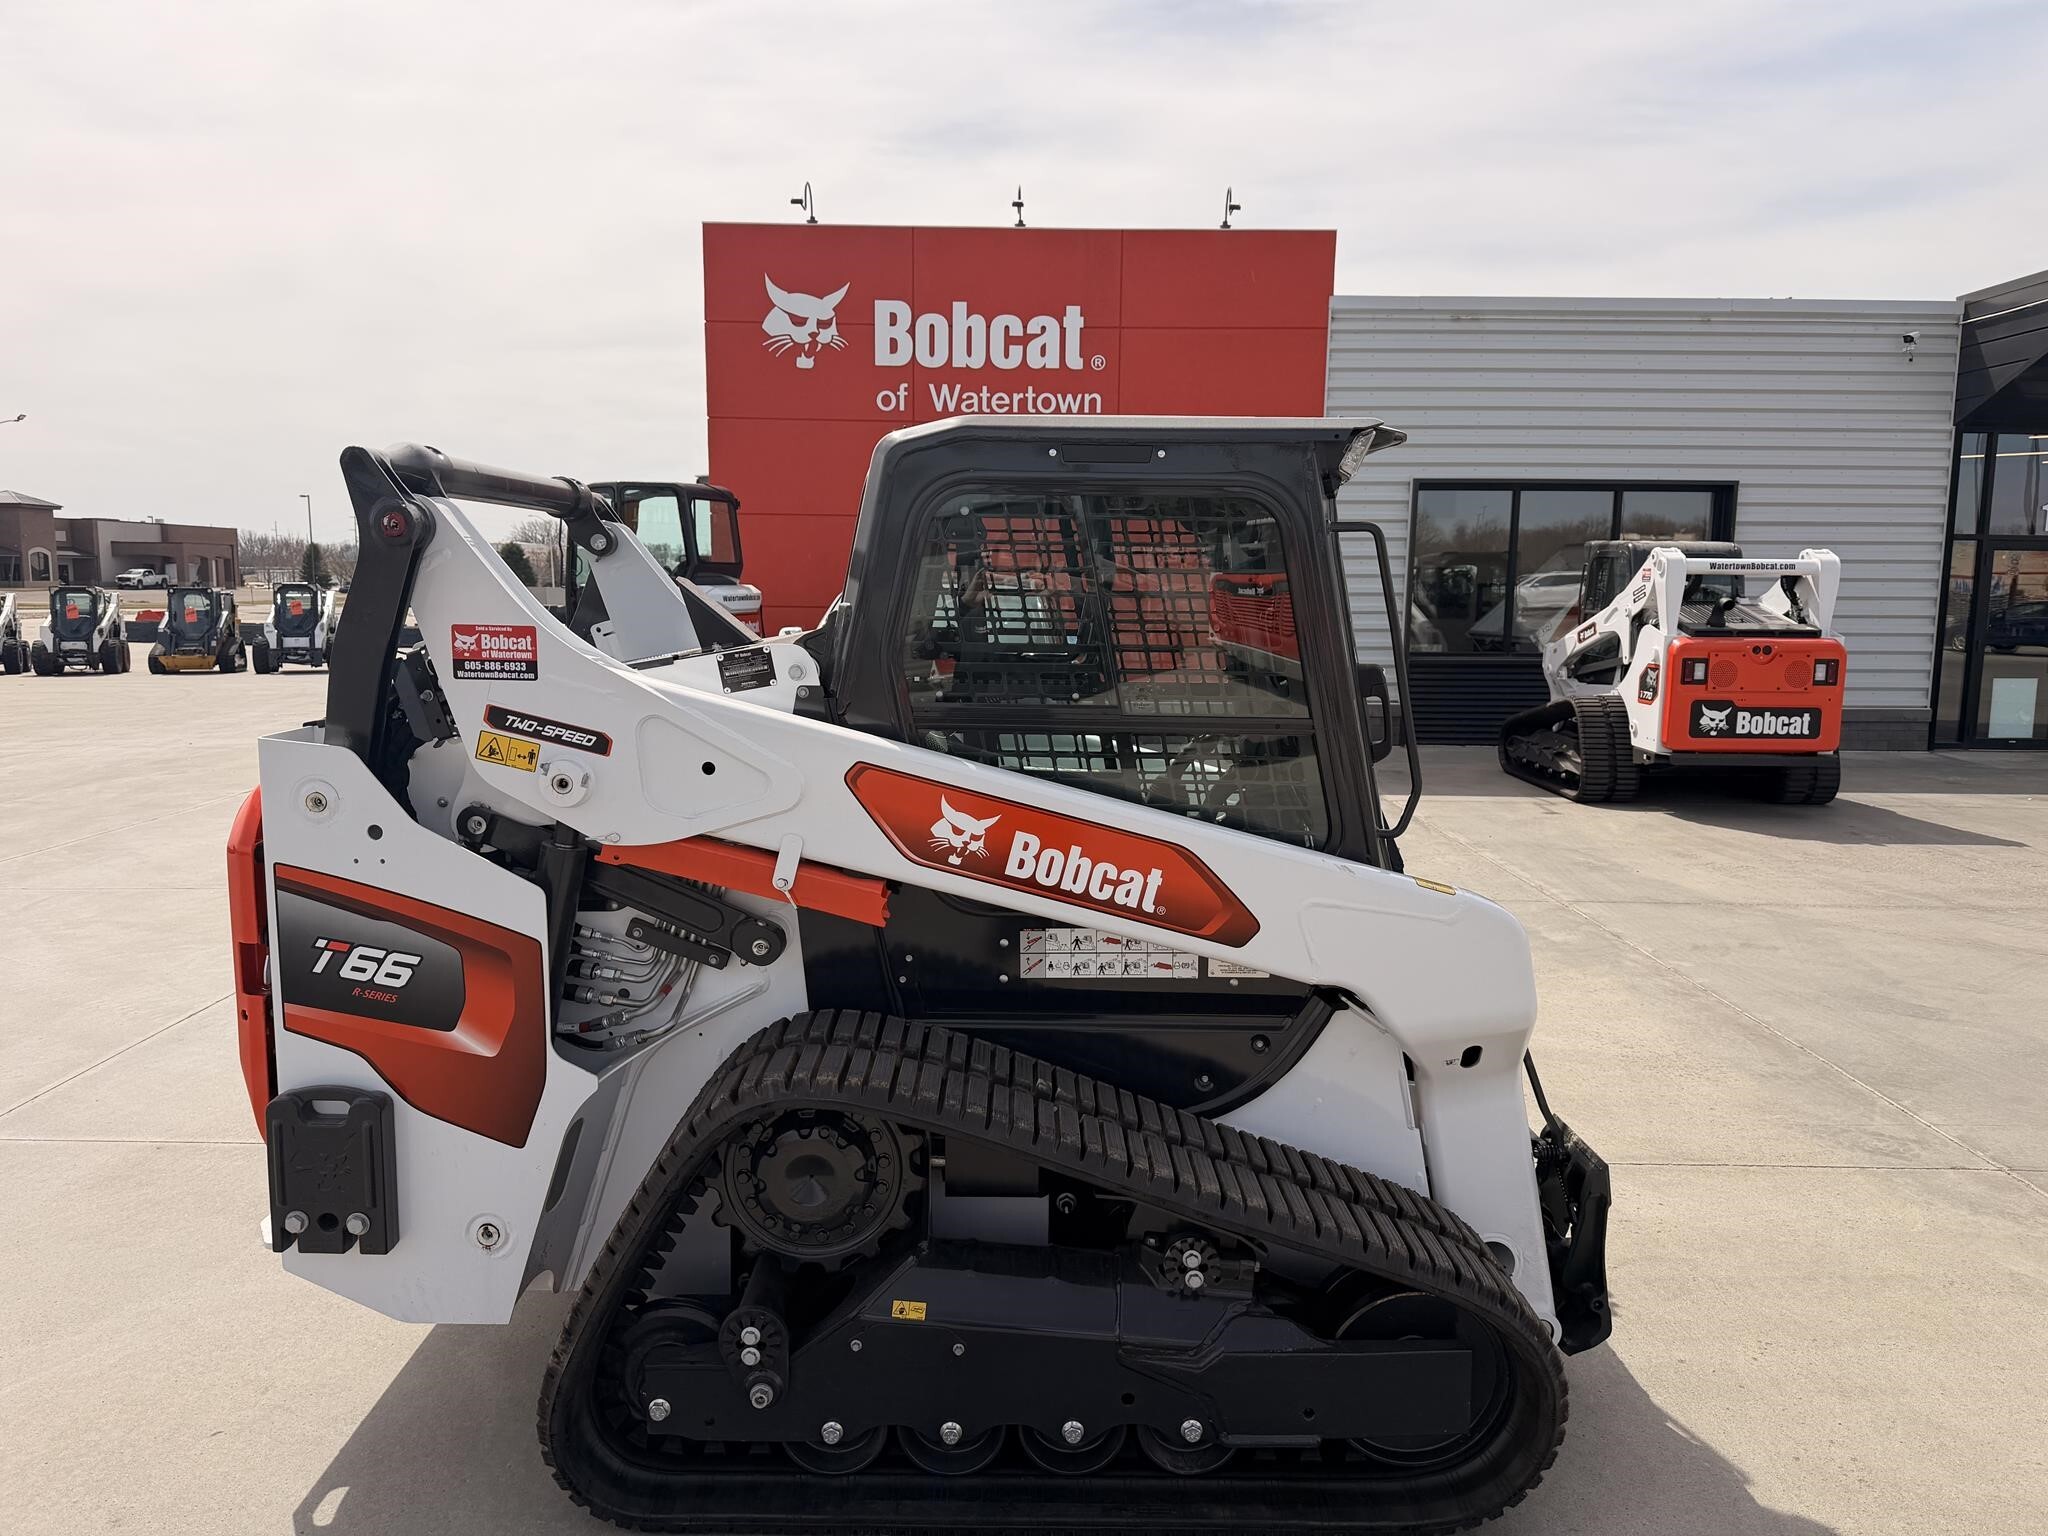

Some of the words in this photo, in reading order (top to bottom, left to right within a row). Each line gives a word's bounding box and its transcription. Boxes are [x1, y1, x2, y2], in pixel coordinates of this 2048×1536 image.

[874, 299, 1085, 370] Bobcat
[876, 383, 909, 412] of
[929, 383, 1102, 414] Watertown
[1709, 561, 1796, 571] WatertownBobcat.com
[480, 633, 532, 650] Bobcat
[481, 650, 489, 658] of
[490, 650, 533, 659] Watertown
[456, 670, 535, 679] WatertownBobcat.com
[464, 661, 527, 671] 605-886-6933
[505, 715, 597, 747] TWO-SPEED
[1735, 711, 1811, 735] Bobcat
[1003, 830, 1165, 914] Bobcat
[312, 938, 422, 988] T66
[351, 986, 399, 1004] R-SERIES
